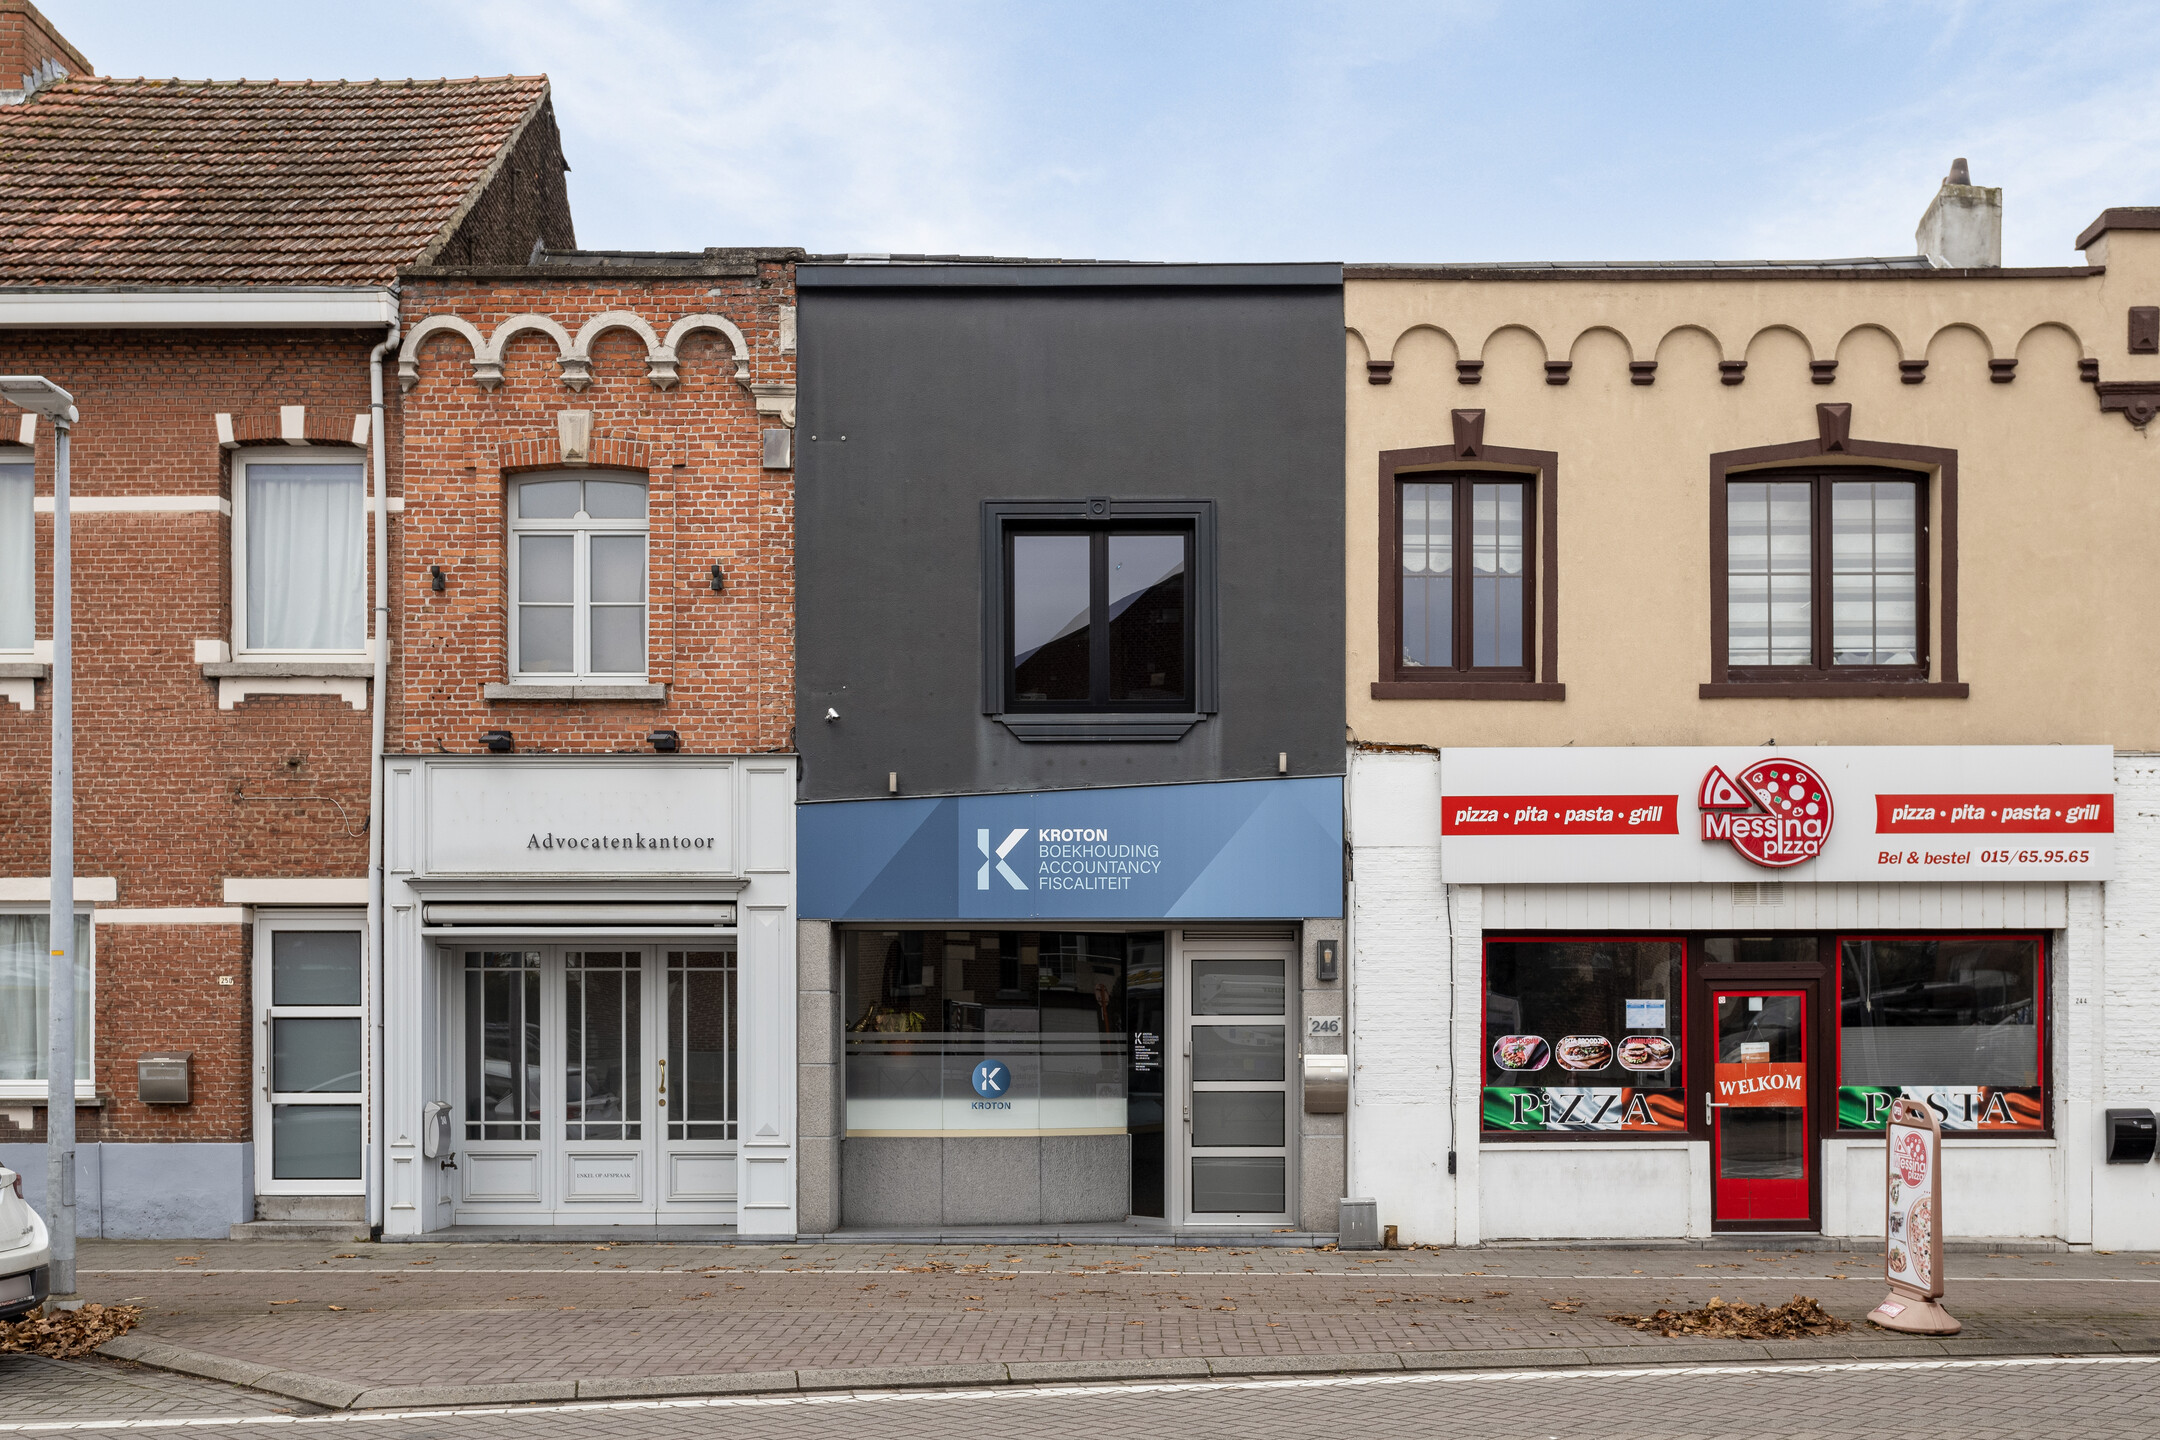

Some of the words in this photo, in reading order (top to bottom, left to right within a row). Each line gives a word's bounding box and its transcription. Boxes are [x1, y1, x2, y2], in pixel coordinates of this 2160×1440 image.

[1455, 806, 1498, 825] pizza
[1514, 806, 1548, 825] pita
[1564, 806, 1613, 825] pasta
[1628, 806, 1663, 825] grill
[1892, 804, 1935, 823] pizza
[1951, 804, 1985, 823] pita
[2001, 804, 2050, 823] pasta
[2065, 804, 2100, 823] grill
[1706, 813, 1822, 838] Messina
[526, 832, 715, 850] Advocatenkantoor
[1039, 828, 1108, 842] KROTON
[1039, 844, 1160, 858] BOEKHOUDING
[1763, 840, 1819, 858] pizza
[1877, 851, 1902, 865] Bel
[1906, 851, 1920, 865] &
[1924, 850, 1970, 865] bestel
[1980, 849, 2090, 864] 015/65.95.65
[1039, 860, 1162, 874] ACCOUNTANCY
[1039, 877, 1132, 890] FISCALITEIT
[1312, 1020, 1338, 1032] 246
[1719, 1073, 1802, 1096] WELKOM
[971, 1101, 1011, 1110] KROTON
[1862, 1091, 2018, 1124] PSTA
